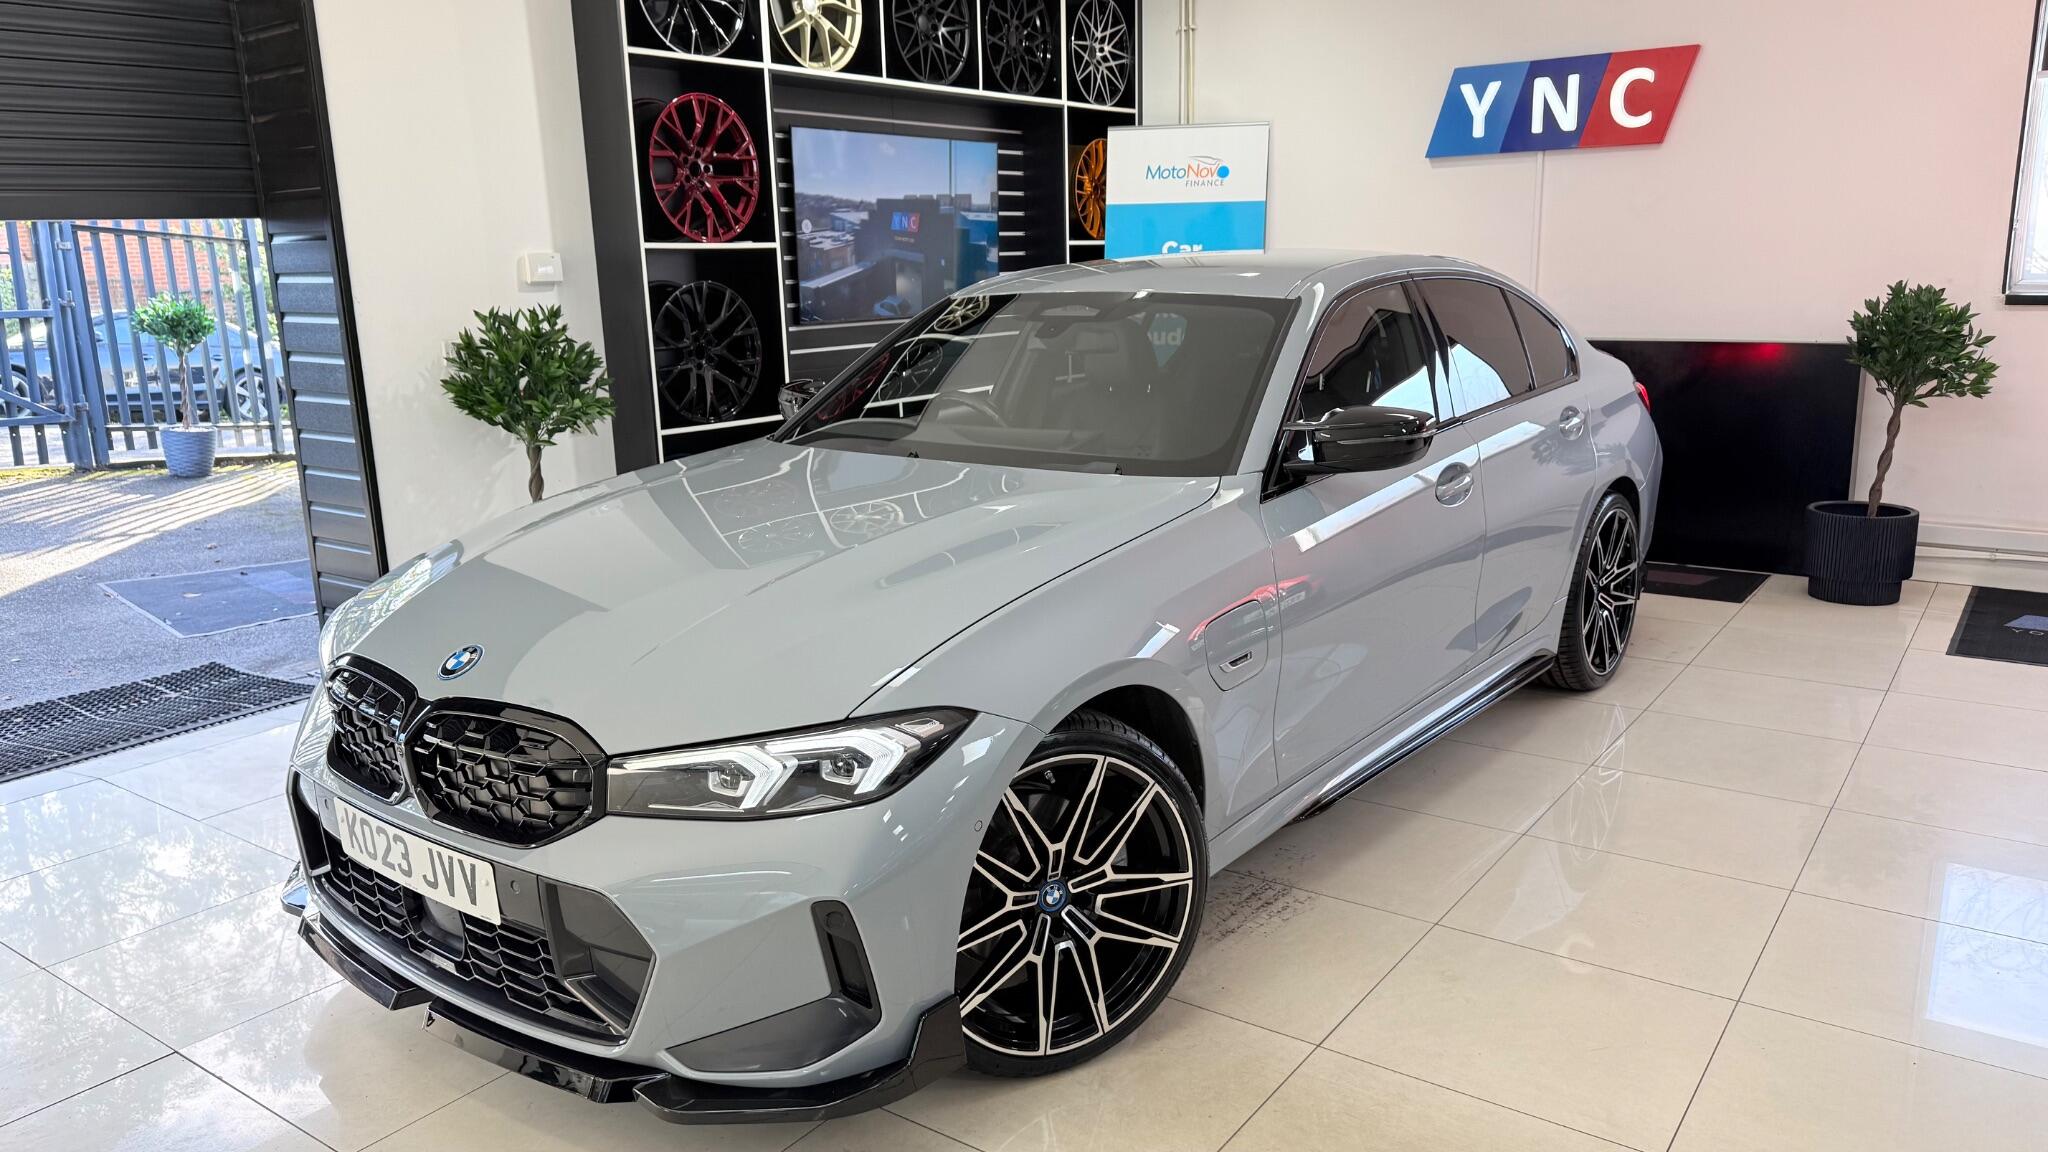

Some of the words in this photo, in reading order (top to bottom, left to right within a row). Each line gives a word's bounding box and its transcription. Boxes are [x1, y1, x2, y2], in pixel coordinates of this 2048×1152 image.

[1460, 67, 1655, 138] YNC
[1145, 163, 1230, 180] MotoNovo
[1185, 179, 1225, 188] FINANCE
[1161, 240, 1203, 254] Car
[344, 807, 413, 879] KO23
[422, 847, 477, 907] JVV
